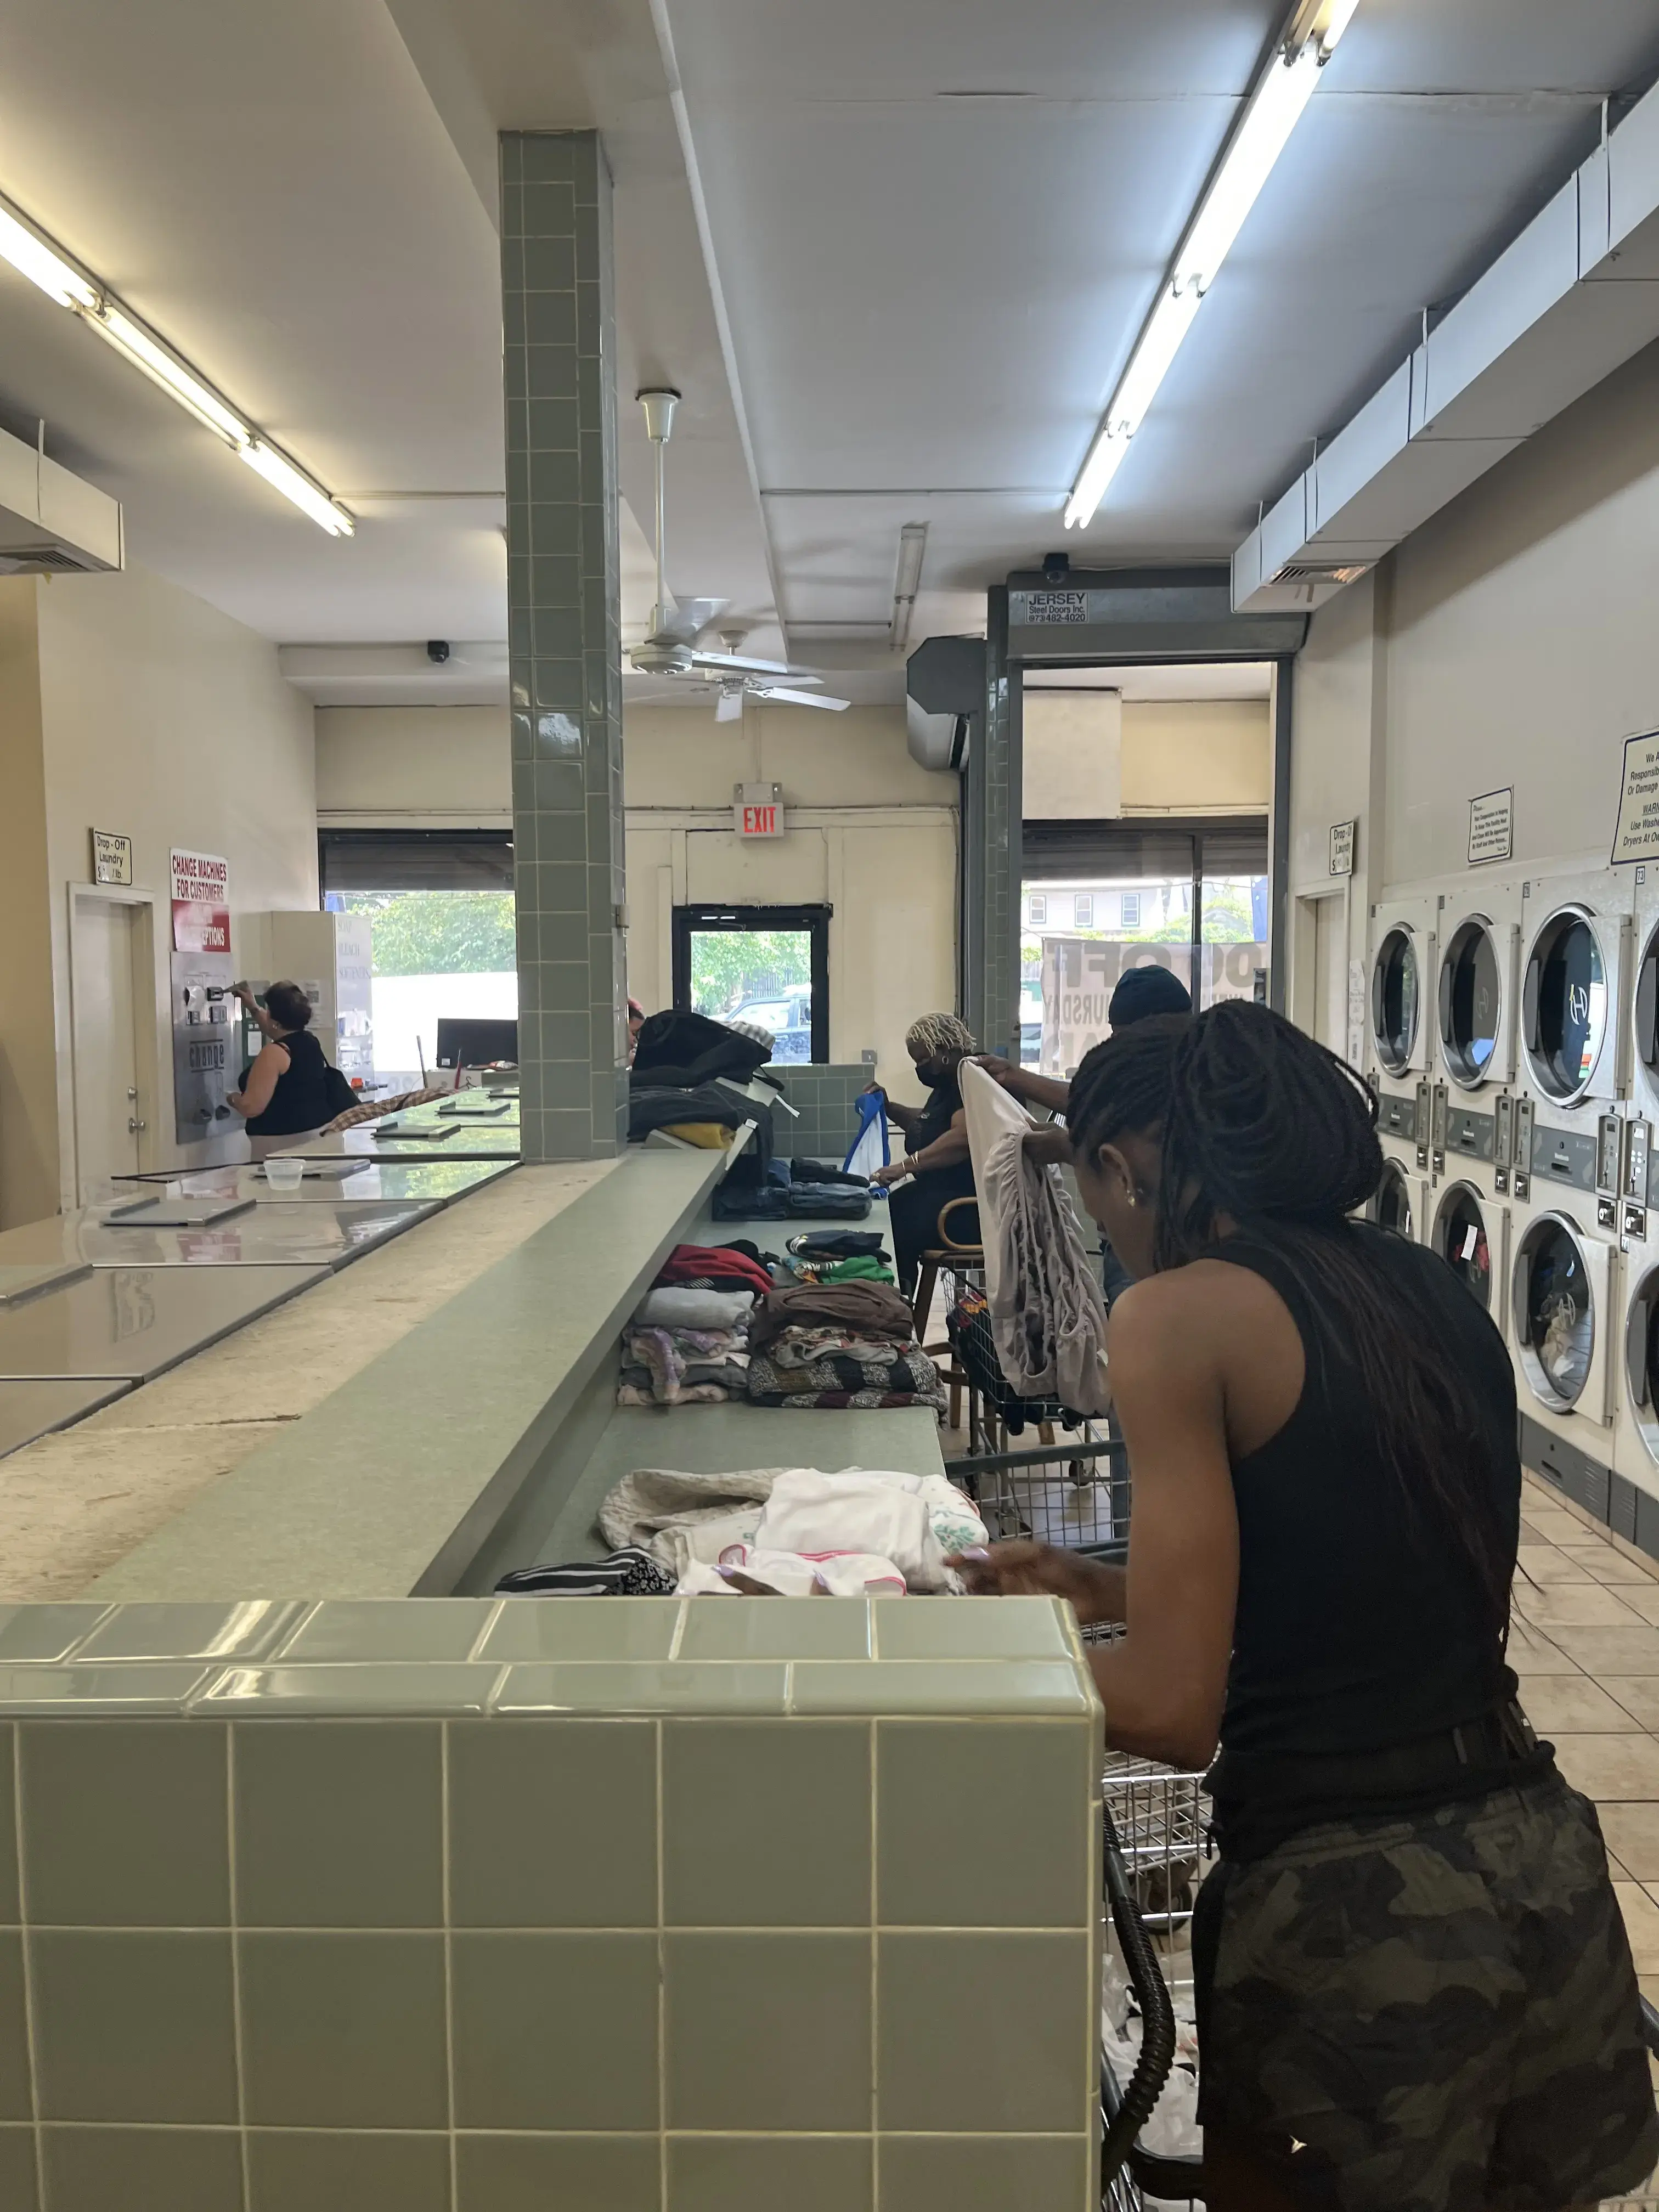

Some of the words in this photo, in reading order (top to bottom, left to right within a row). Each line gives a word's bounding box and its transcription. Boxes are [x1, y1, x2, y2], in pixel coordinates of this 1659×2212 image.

[1029, 592, 1086, 605] JERSEY
[1049, 605, 1070, 613] Doors
[1646, 753, 1654, 763] We
[1628, 786, 1635, 795] Or
[1635, 782, 1658, 794] Damage
[744, 806, 776, 833] EXIT
[1630, 821, 1640, 831] Use
[1623, 835, 1642, 848] Dryers
[1643, 833, 1650, 843] At
[99, 851, 123, 867] Laundry
[172, 855, 196, 877] CHANGE
[198, 859, 227, 882] MACHINES
[177, 878, 189, 899] FOR
[190, 880, 224, 902] CUSTOMERS
[189, 1044, 224, 1068] change
